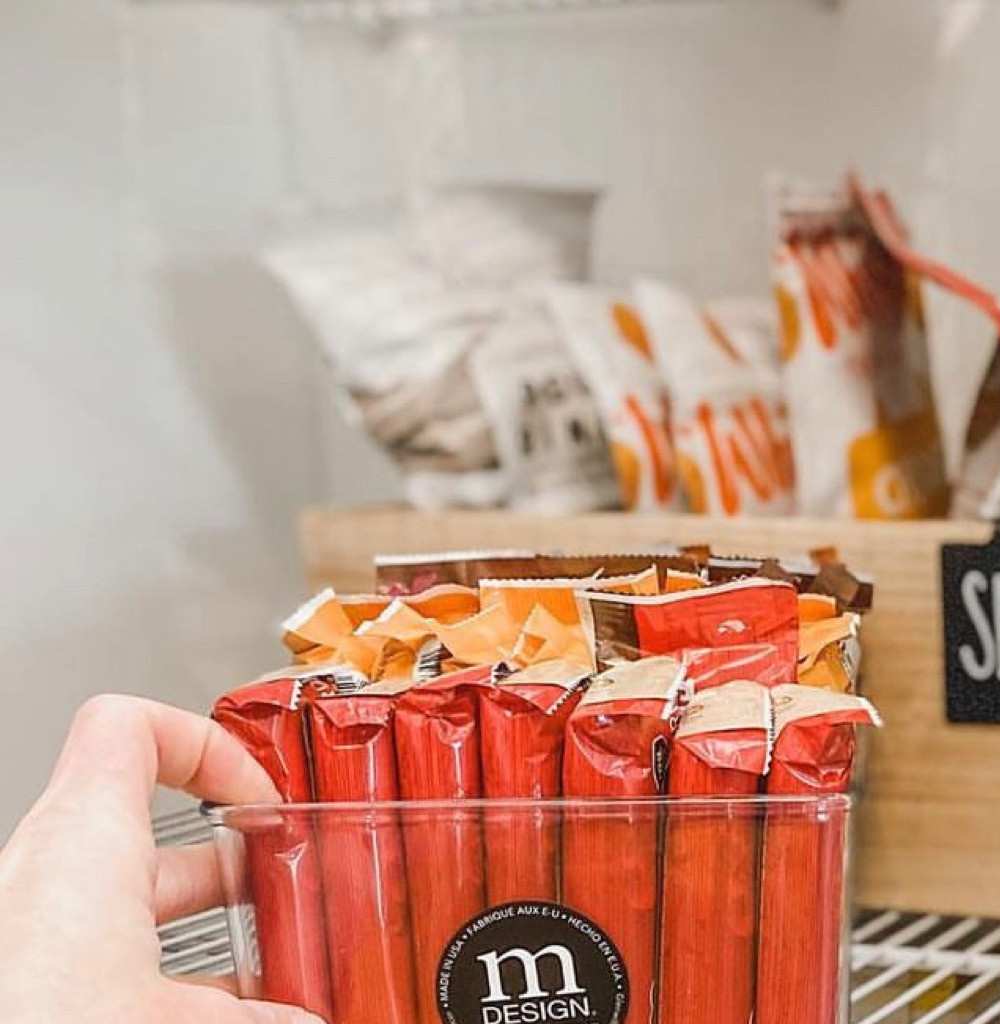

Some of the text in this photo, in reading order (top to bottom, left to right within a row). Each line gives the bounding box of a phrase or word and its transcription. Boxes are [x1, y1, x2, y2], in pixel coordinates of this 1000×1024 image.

[517, 905, 540, 916] AUX
[567, 915, 602, 943] HECHO
[476, 944, 587, 1003] m
